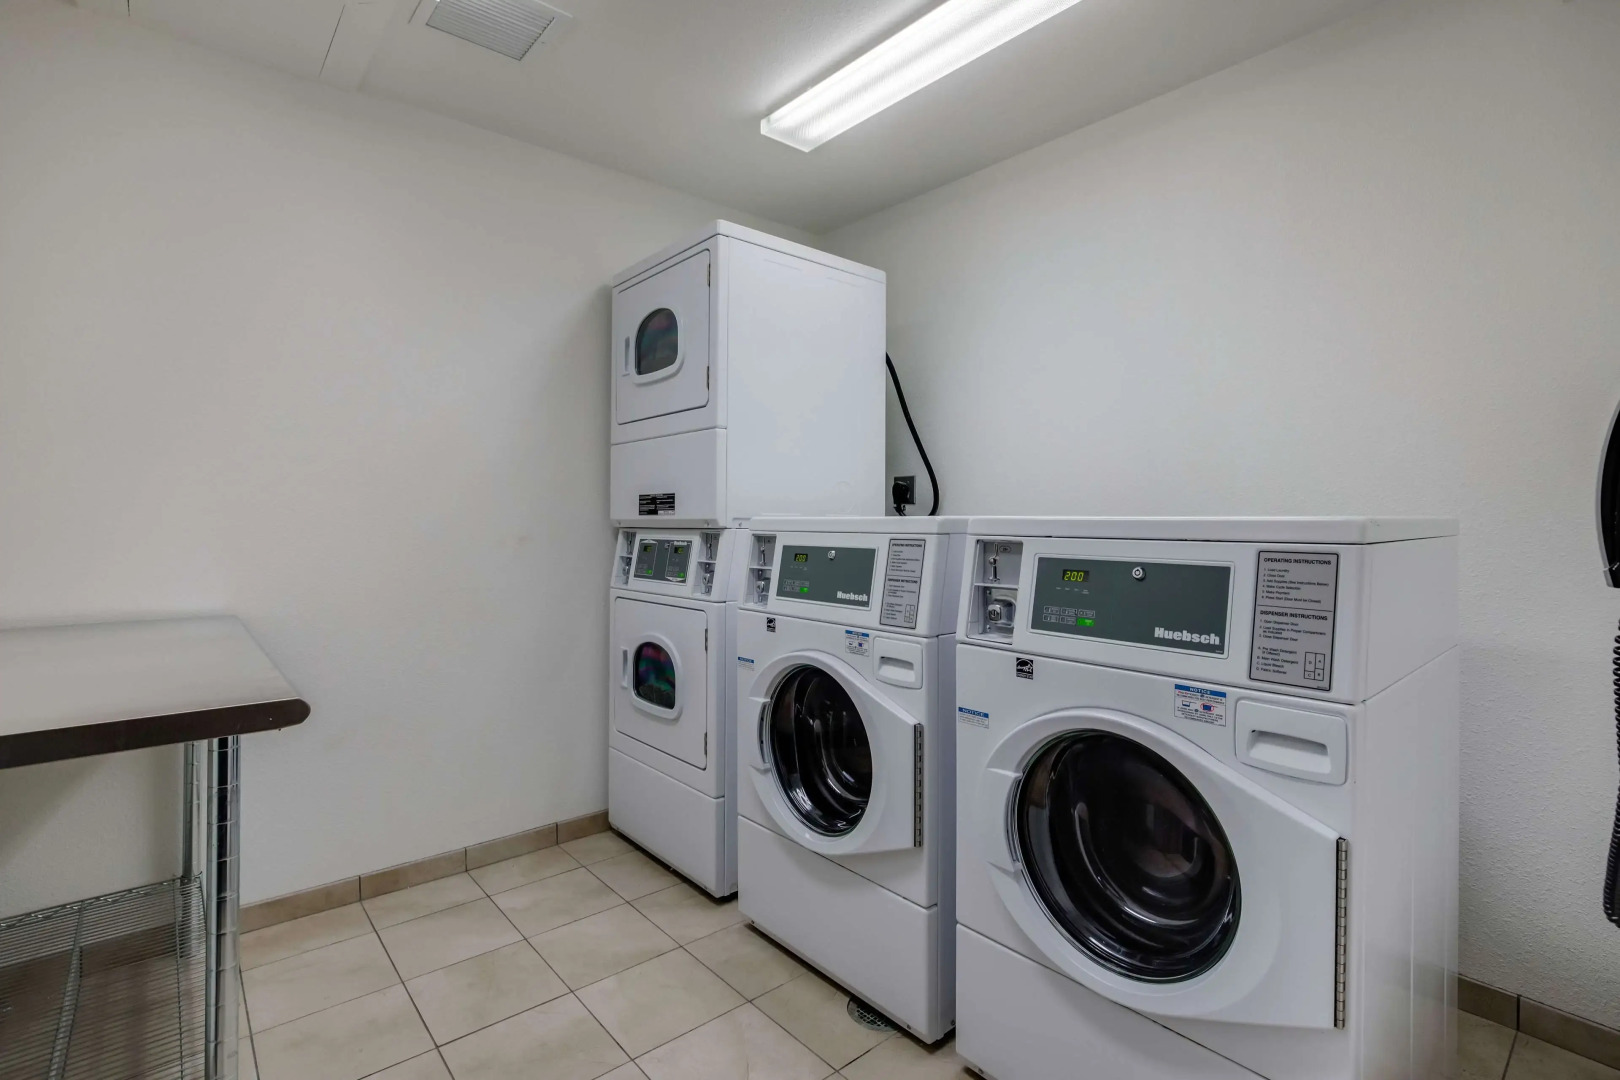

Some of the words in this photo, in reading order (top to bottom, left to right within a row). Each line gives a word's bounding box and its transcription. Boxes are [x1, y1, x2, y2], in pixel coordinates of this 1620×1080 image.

[1064, 571, 1084, 581] 200
[837, 591, 868, 601] Huebsch
[1154, 627, 1220, 645] Huebsch
[962, 708, 984, 717] NOTICE
